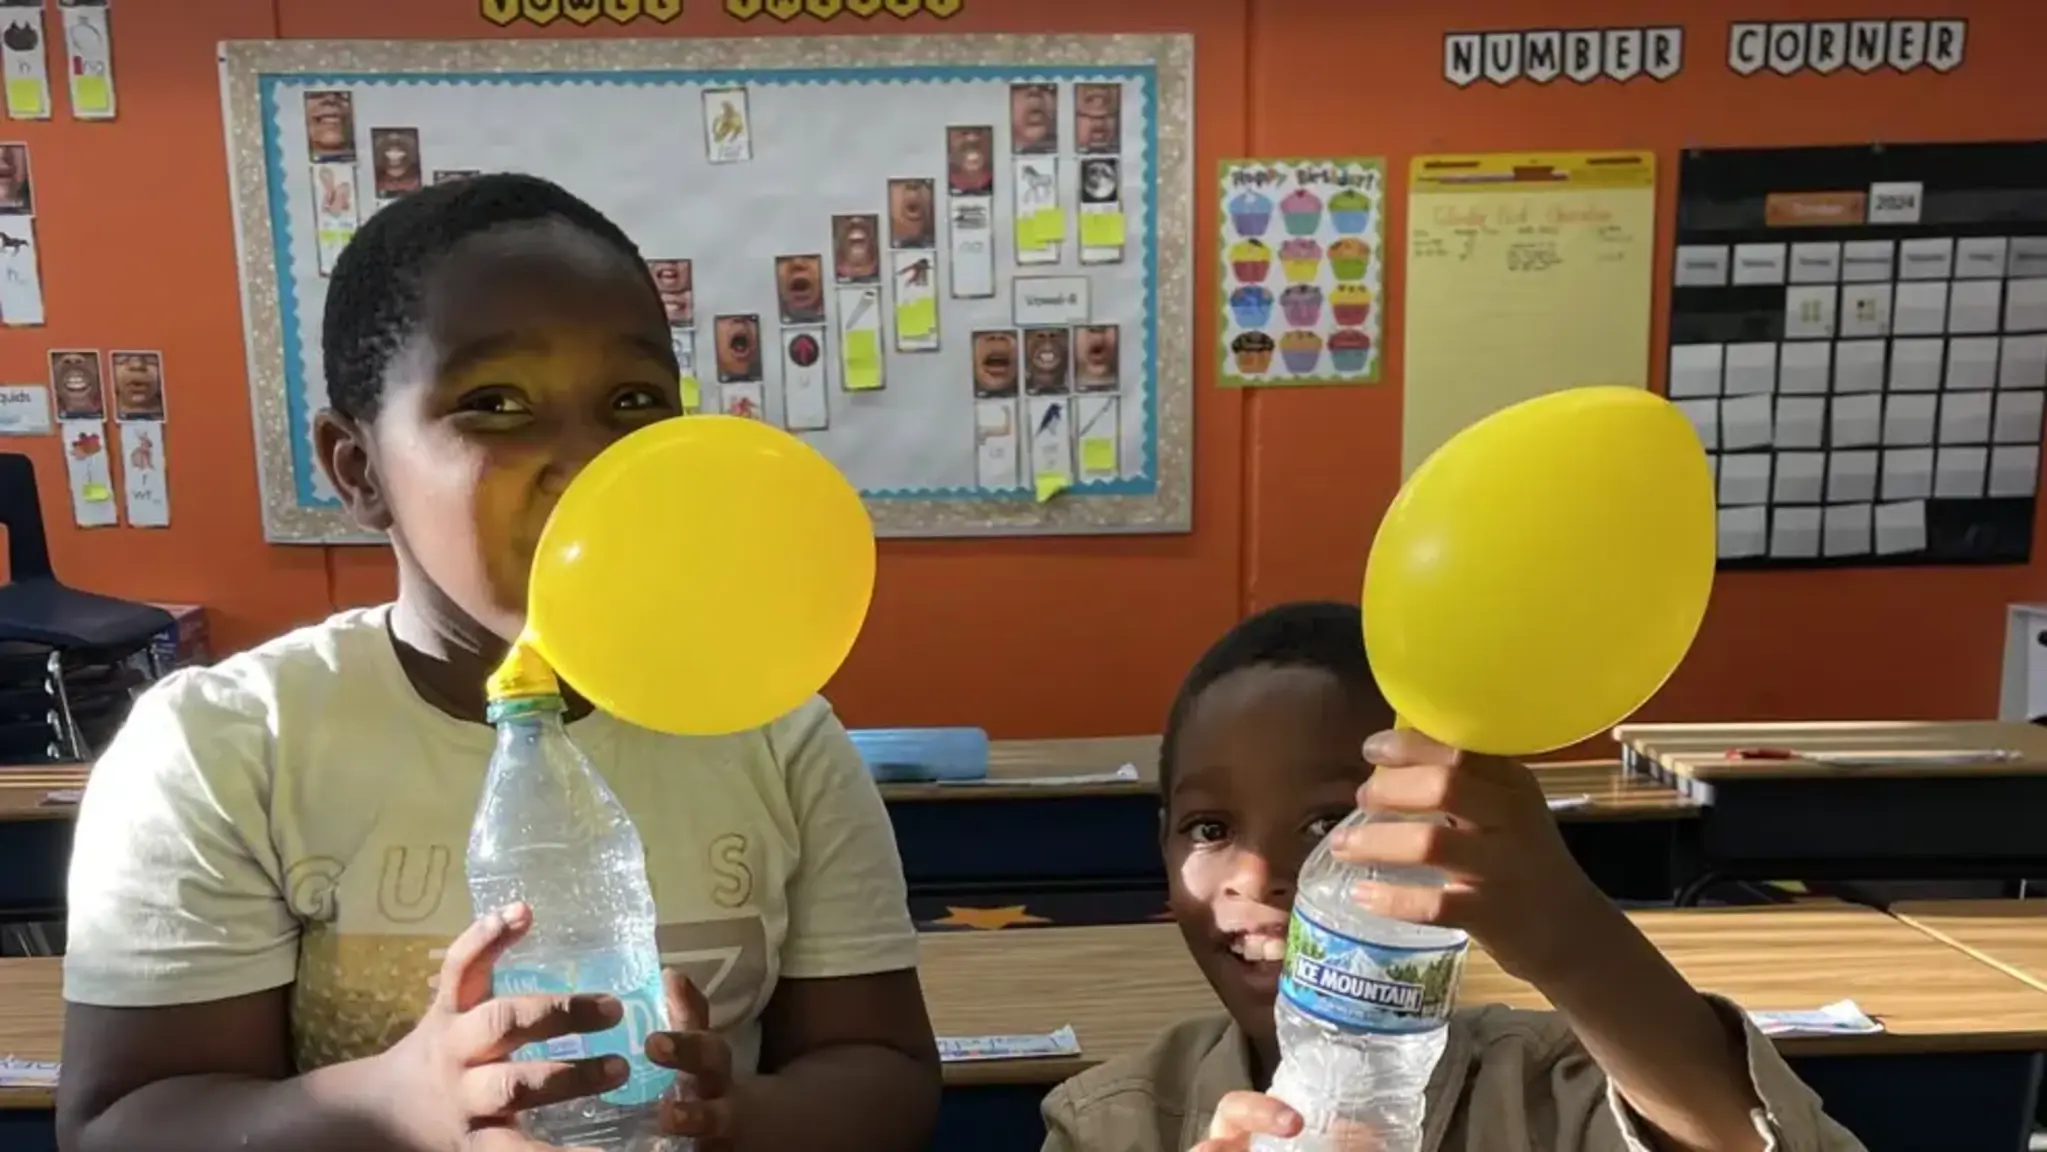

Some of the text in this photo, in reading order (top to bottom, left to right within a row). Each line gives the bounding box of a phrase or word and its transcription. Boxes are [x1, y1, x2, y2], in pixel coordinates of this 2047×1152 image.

[1452, 28, 1953, 74] NUMBER CORNER
[1231, 168, 1288, 188] Happy
[1297, 959, 1320, 984] ICE
[1320, 965, 1420, 1010] MOUNTAIN
